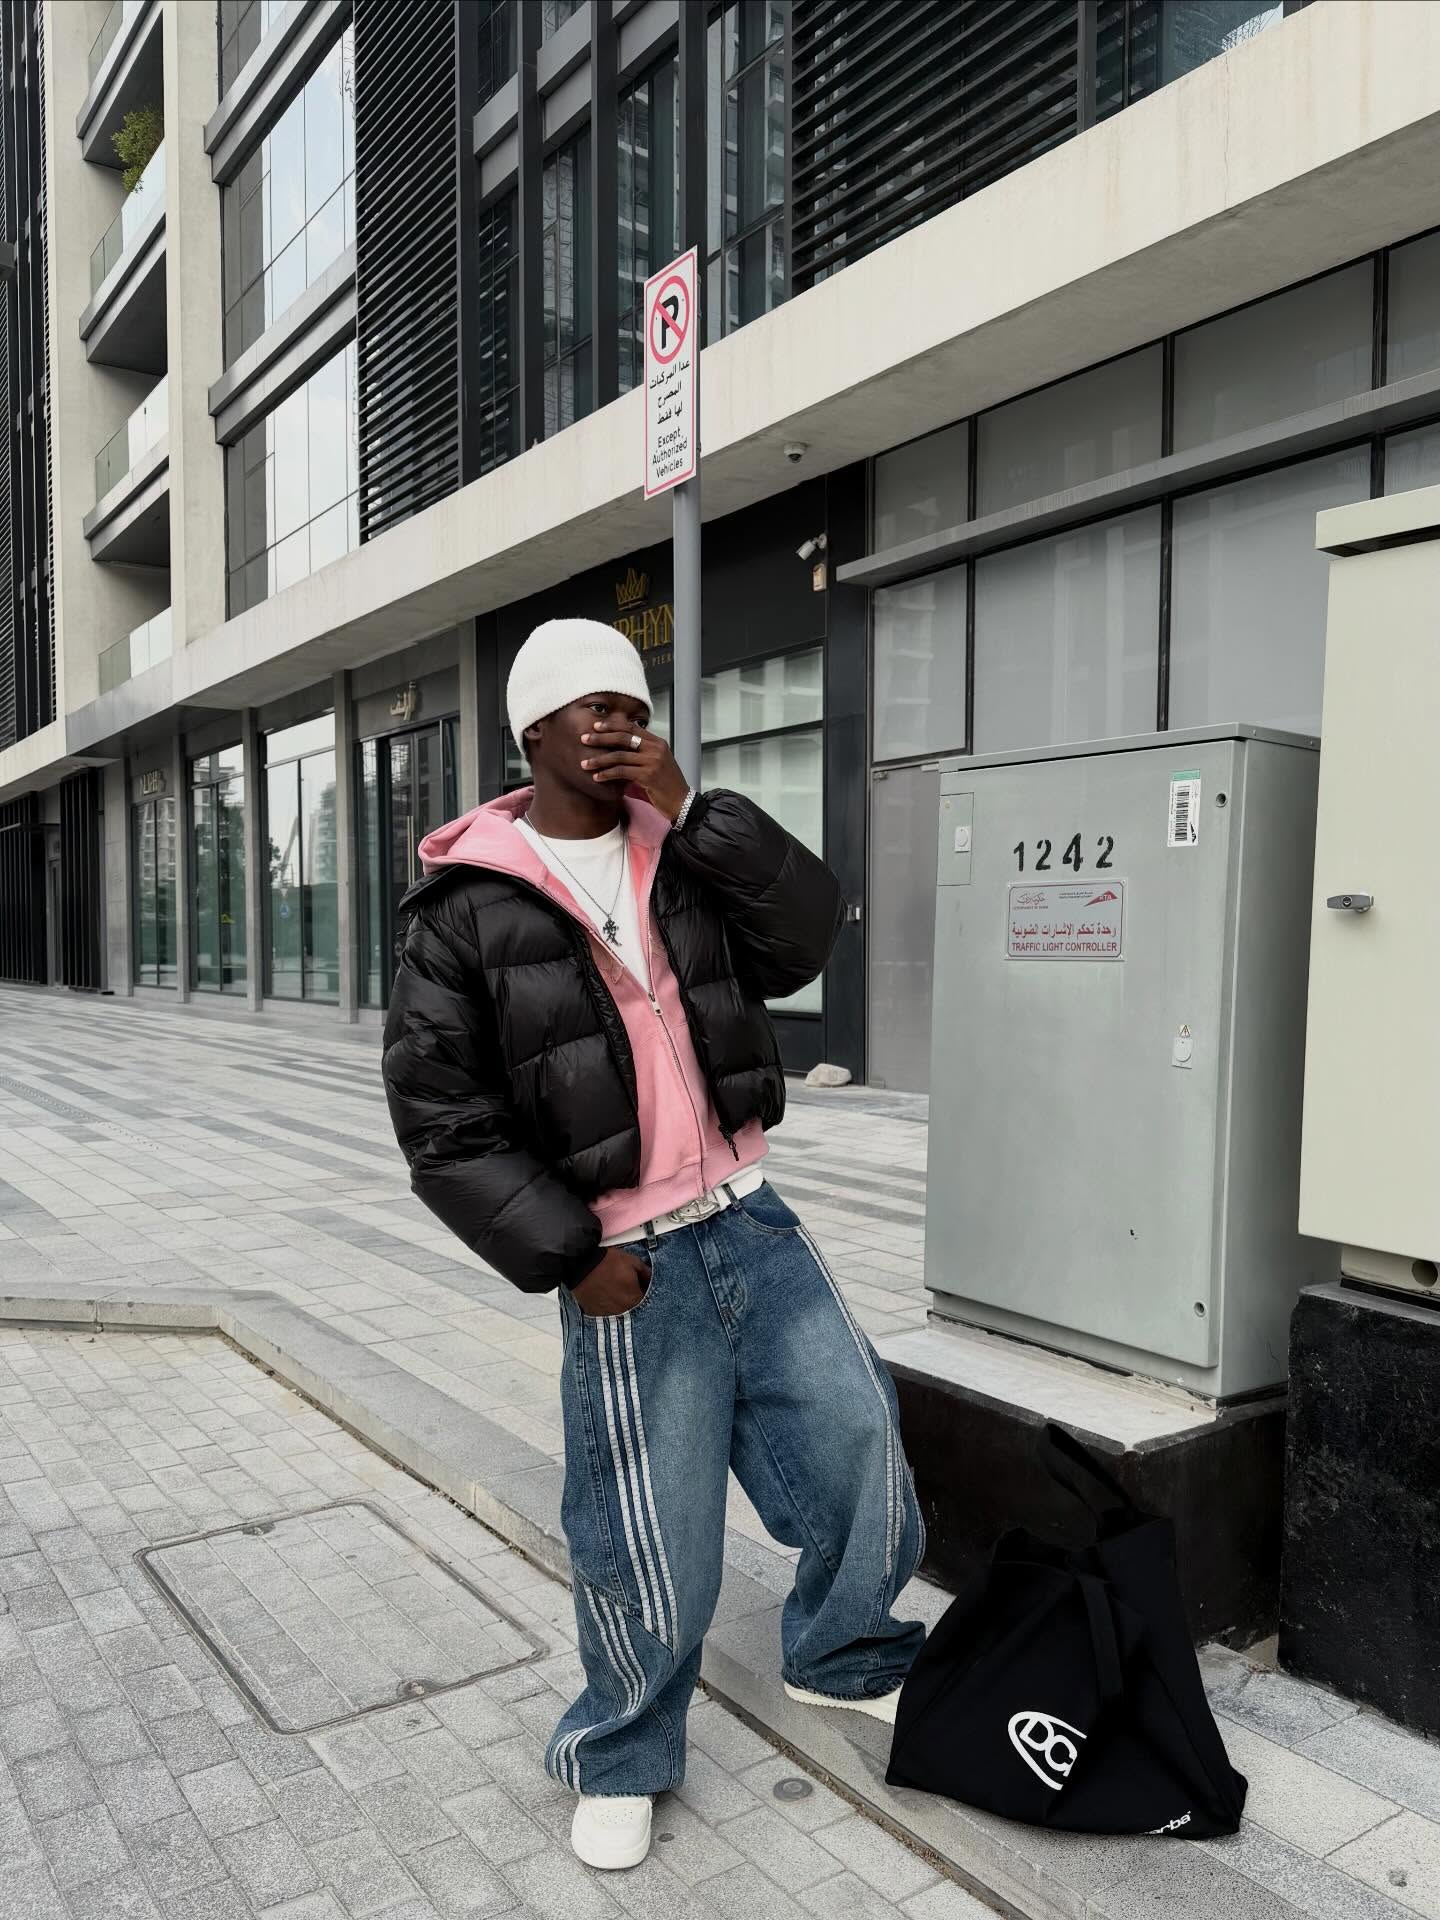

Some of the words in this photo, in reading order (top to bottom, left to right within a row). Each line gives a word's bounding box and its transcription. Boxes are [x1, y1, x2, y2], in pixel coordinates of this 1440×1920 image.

[679, 360, 690, 371] عدا
[649, 363, 677, 389] المركبات
[657, 380, 682, 408] المصرح
[657, 407, 672, 425] فقط
[674, 401, 683, 417] لها
[657, 426, 681, 448] Except
[652, 436, 688, 464] Authorized
[656, 458, 683, 478] Vehicles
[1013, 832, 1114, 872] 1242
[1076, 923, 1095, 940] تحكم
[1012, 942, 1040, 952] TRAFFIC
[1042, 942, 1064, 952] LIGHT
[1065, 942, 1117, 952] CONTROLLER
